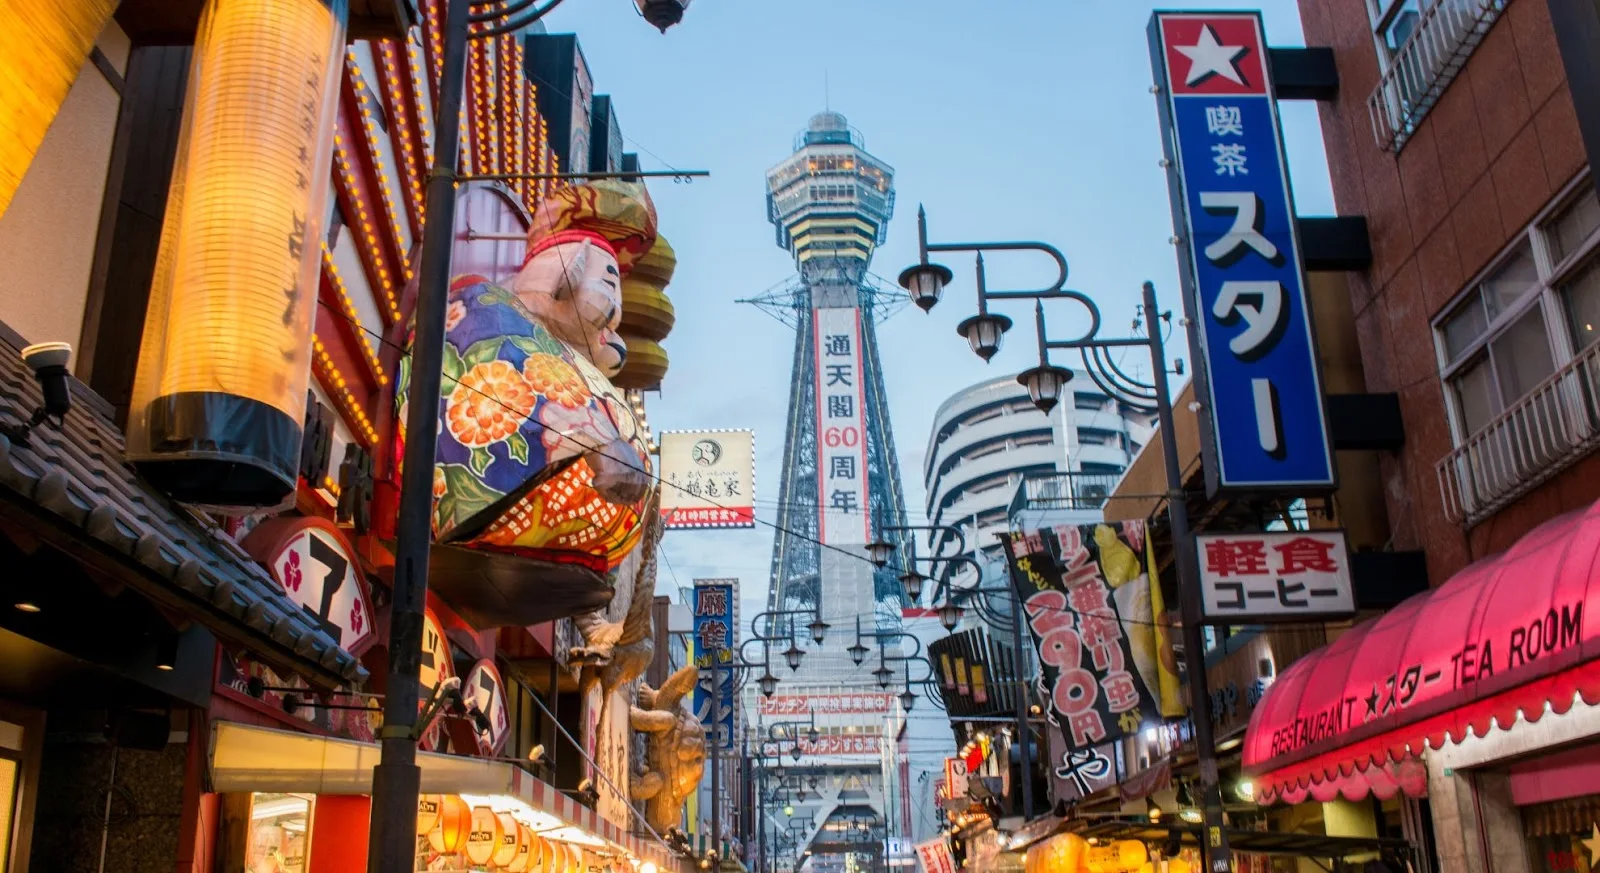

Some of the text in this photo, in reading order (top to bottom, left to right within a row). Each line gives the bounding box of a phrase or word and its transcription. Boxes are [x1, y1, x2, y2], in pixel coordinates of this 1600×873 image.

[1205, 105, 1249, 177] 喫茶
[1199, 191, 1281, 455] スター
[824, 334, 859, 515] 通天閣60周年
[1205, 537, 1340, 577] 軽食
[696, 587, 728, 649] 麻雀
[1214, 578, 1339, 609] コーヒー
[1271, 697, 1358, 758] RESTAURANT
[1381, 664, 1442, 717] スター
[1451, 639, 1494, 690] TEA
[1508, 601, 1583, 670] ROOM
